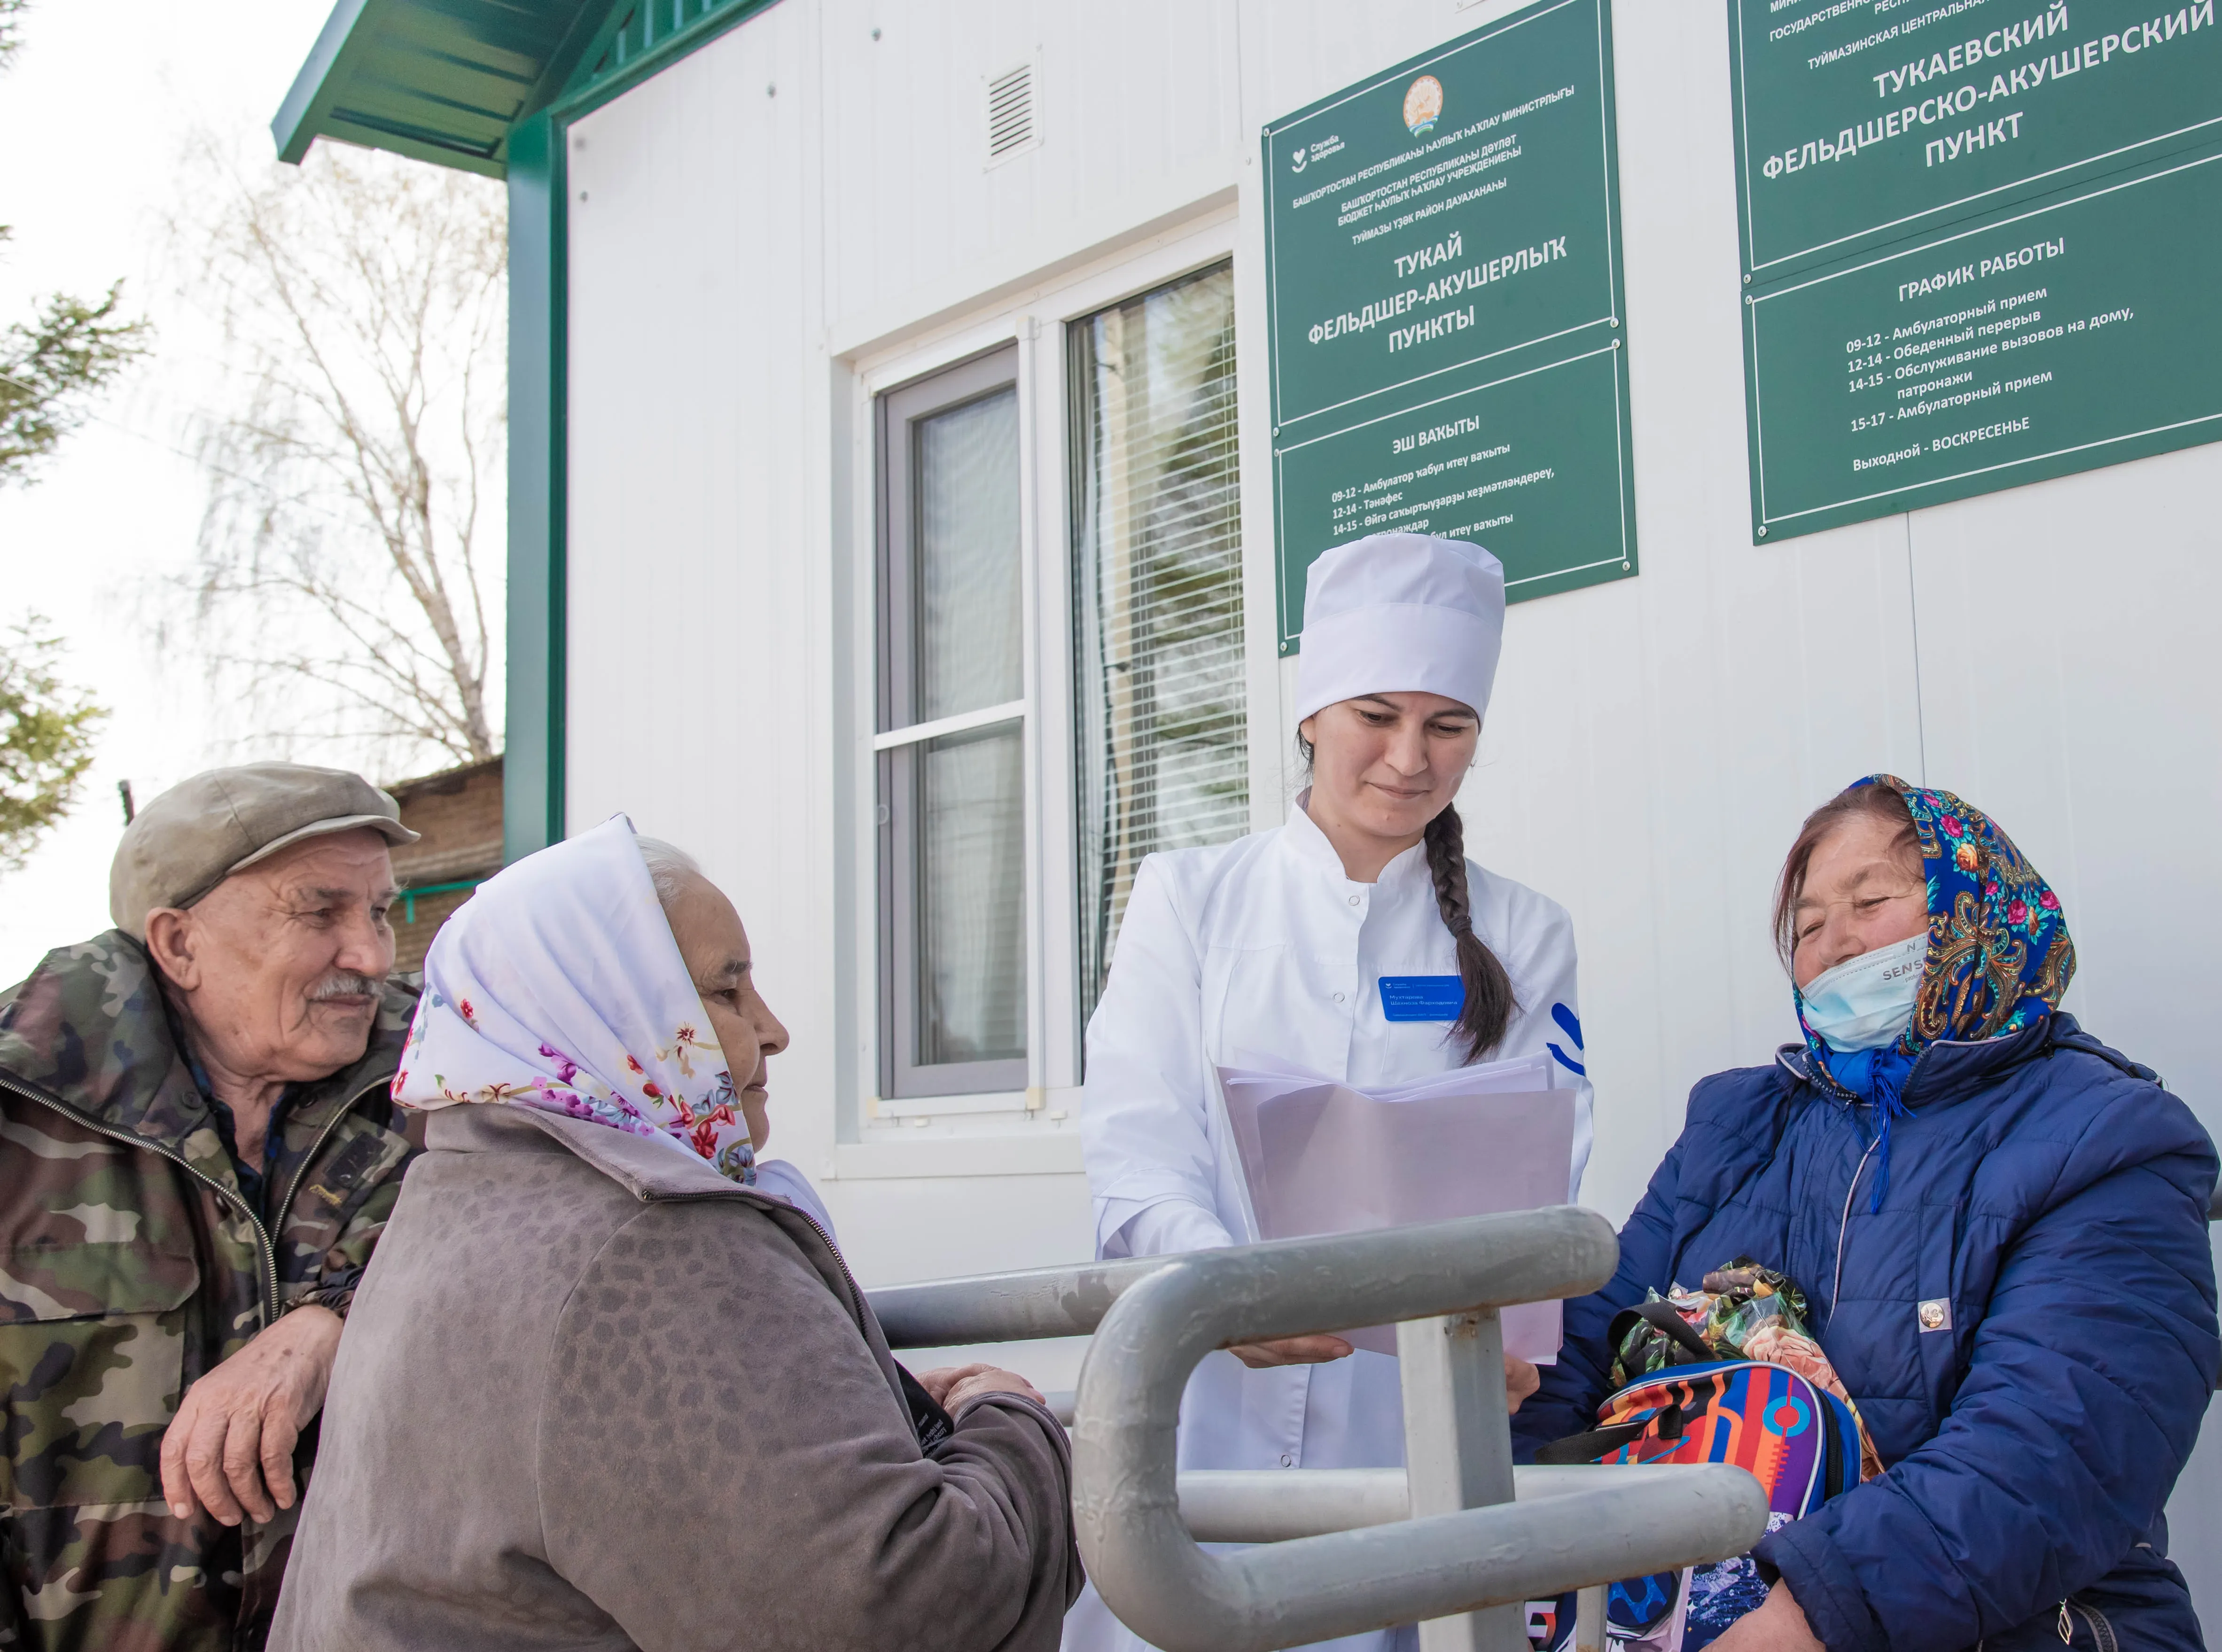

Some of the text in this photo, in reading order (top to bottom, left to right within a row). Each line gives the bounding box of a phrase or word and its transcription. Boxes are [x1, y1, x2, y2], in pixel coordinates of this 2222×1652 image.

[1808, 25, 1899, 70] ТУЙМАЗИНСКАЯ
[1873, 0, 2068, 98] ТУКАЕВСКИЙ
[1763, 0, 2214, 179] ФЕЛЬДШЕРСКО-АКУШЕРСКИЙ
[1926, 111, 2023, 167] ПУНКТ
[1338, 204, 1373, 226] БЮДЖЕТ
[1352, 222, 1392, 245] ТУЙМАЗЫ
[1415, 202, 1444, 220] РАЙОН
[1394, 231, 1462, 278] ТУКАЙ
[1899, 237, 2064, 302] ГРАФИК РАБОТЫ
[1389, 305, 1474, 353] ПУНКТЫ
[1846, 333, 1881, 353] 09-12
[1893, 299, 1996, 340] Амбулаторный
[2000, 288, 2047, 310] прием
[1848, 353, 1883, 373] 12-14
[1894, 326, 1974, 359] Обеденный
[1978, 311, 2041, 336] перерыв
[1849, 373, 1883, 392] 14-15
[1895, 344, 1997, 379] Обслуживание
[2002, 326, 2064, 351] вызовов
[2068, 320, 2085, 333] на
[2089, 307, 2134, 330] дому,
[1851, 412, 1885, 432] 15-17
[1897, 381, 2001, 420] Амбулаторный
[2005, 371, 2052, 392] прием
[1897, 371, 1973, 399] патронажи
[1393, 435, 1415, 454] ЭШ
[1853, 443, 1920, 471] Выходной
[1933, 417, 2030, 452] ВОСКРЕСЕНЬЕ
[1332, 487, 1356, 503] 09-12
[1363, 472, 1414, 494] Амбулатор
[1333, 503, 1357, 519] 12-14
[1364, 492, 1403, 510] Тәнәфес
[1333, 520, 1357, 536] 14-15
[1883, 959, 1923, 980] SENS
